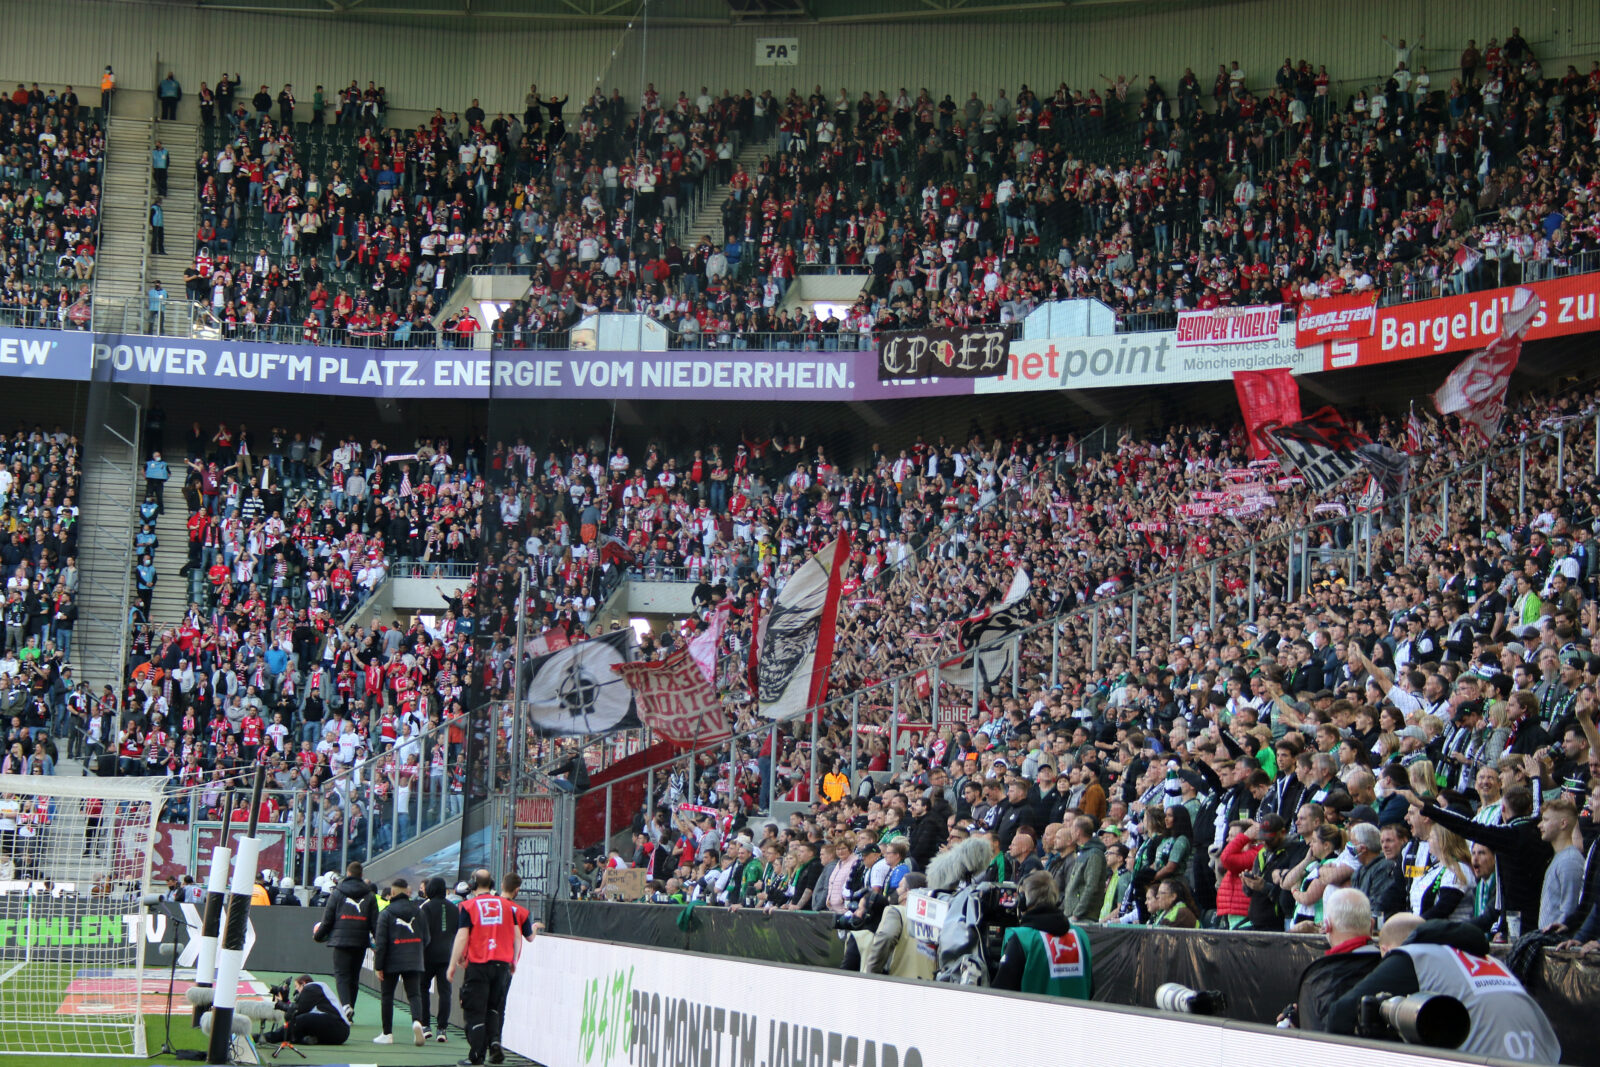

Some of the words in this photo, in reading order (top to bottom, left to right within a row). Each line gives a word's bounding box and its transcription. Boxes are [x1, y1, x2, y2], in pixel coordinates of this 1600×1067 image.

[766, 45, 788, 58] 7A
[1177, 315, 1228, 342] SEMPER
[1231, 310, 1280, 339] FIDELIS
[90, 343, 206, 375] POWER
[214, 351, 311, 381] AUF'M
[319, 357, 426, 386] PLATZ.
[434, 360, 562, 386] ENERGIE
[571, 361, 633, 387] VOM
[641, 362, 856, 389] NIEDERRHEIN.
[1183, 351, 1305, 372] Mönchengladbach
[630, 989, 661, 1067] PRO
[662, 996, 726, 1067] MONAT
[1503, 1031, 1536, 1060] 07
